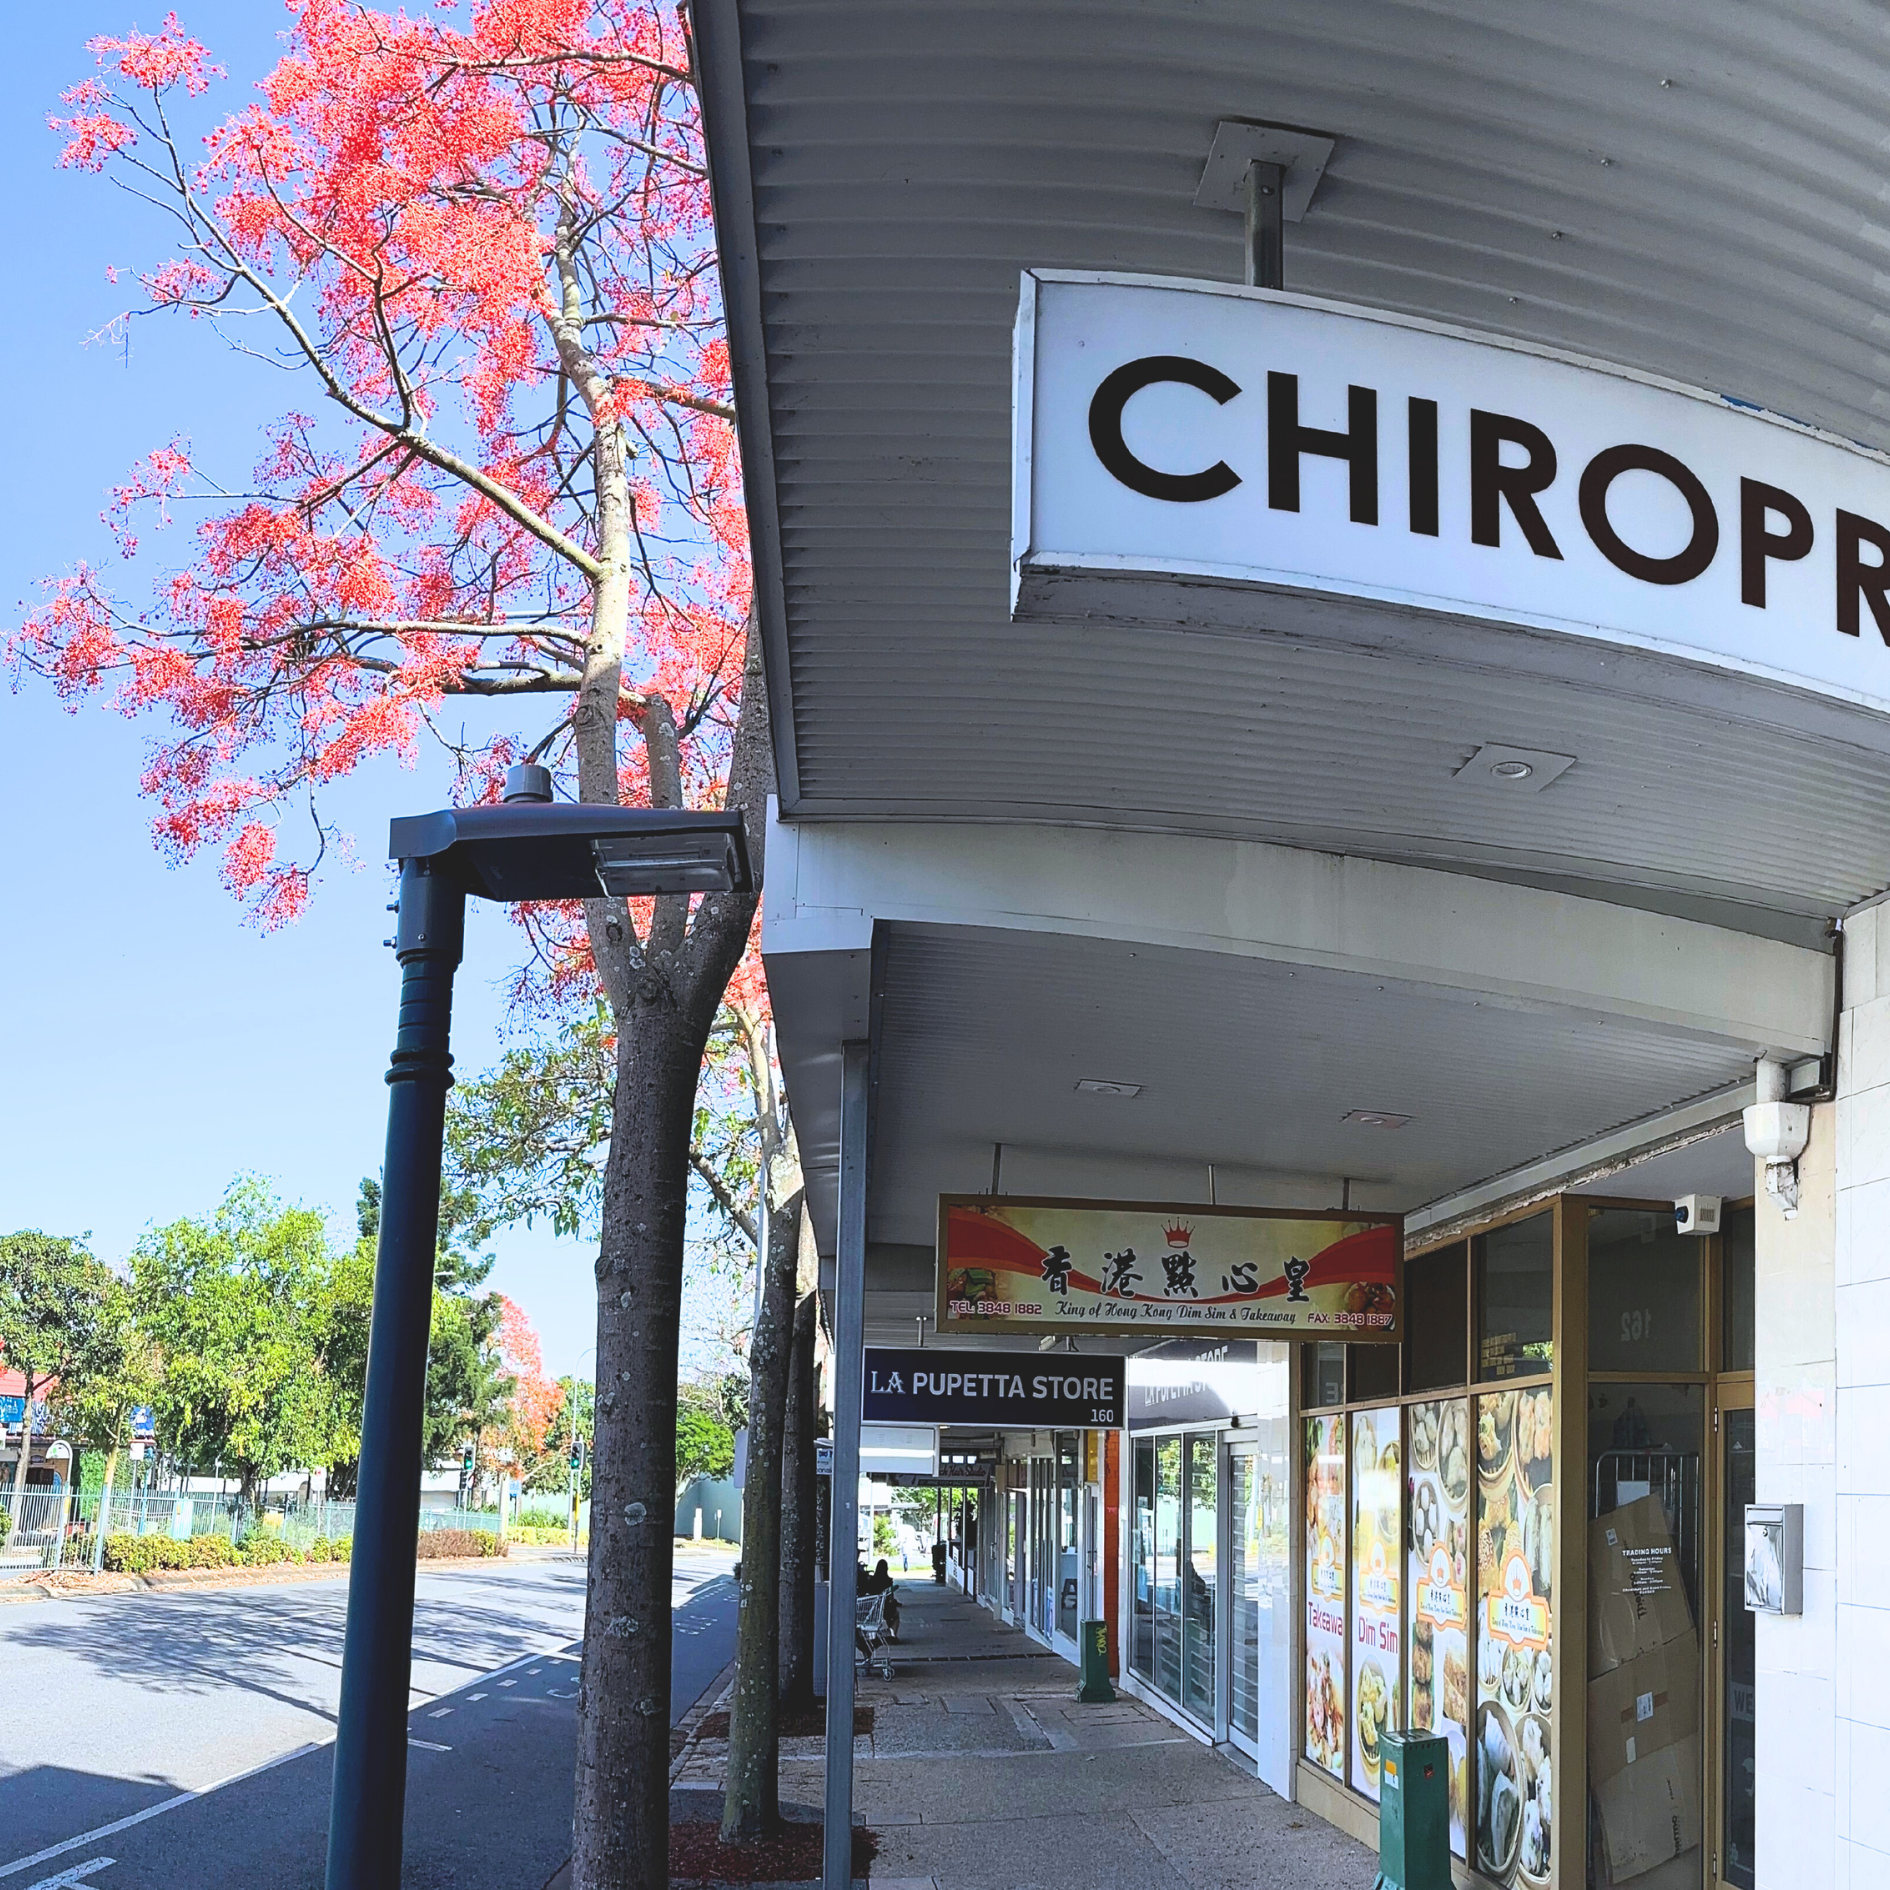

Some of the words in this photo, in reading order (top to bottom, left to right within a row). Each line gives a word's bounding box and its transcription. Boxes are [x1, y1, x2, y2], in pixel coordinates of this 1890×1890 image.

[1041, 1245, 1310, 1303] 香港點心皇
[978, 1302, 1010, 1315] 3848
[1015, 1303, 1042, 1315] 1882
[1055, 1301, 1085, 1318] King
[1089, 1303, 1102, 1318] of
[1104, 1302, 1137, 1319] Hong
[1141, 1303, 1172, 1320] Kong
[1176, 1305, 1202, 1319] Dim
[1205, 1305, 1226, 1319] Sim
[1229, 1306, 1237, 1320] &
[1241, 1307, 1297, 1324] Takeaway
[1334, 1313, 1364, 1325] 3848
[1366, 1313, 1393, 1326] 1887
[870, 1371, 906, 1394] LA
[913, 1372, 1025, 1398] PUPETTA
[1032, 1375, 1113, 1400] STORE
[1090, 1409, 1114, 1422] 160
[1622, 1548, 1650, 1557] TRADING
[1650, 1546, 1672, 1555] HOURS
[1359, 1616, 1376, 1647] Dim
[1379, 1621, 1398, 1654] Sim
